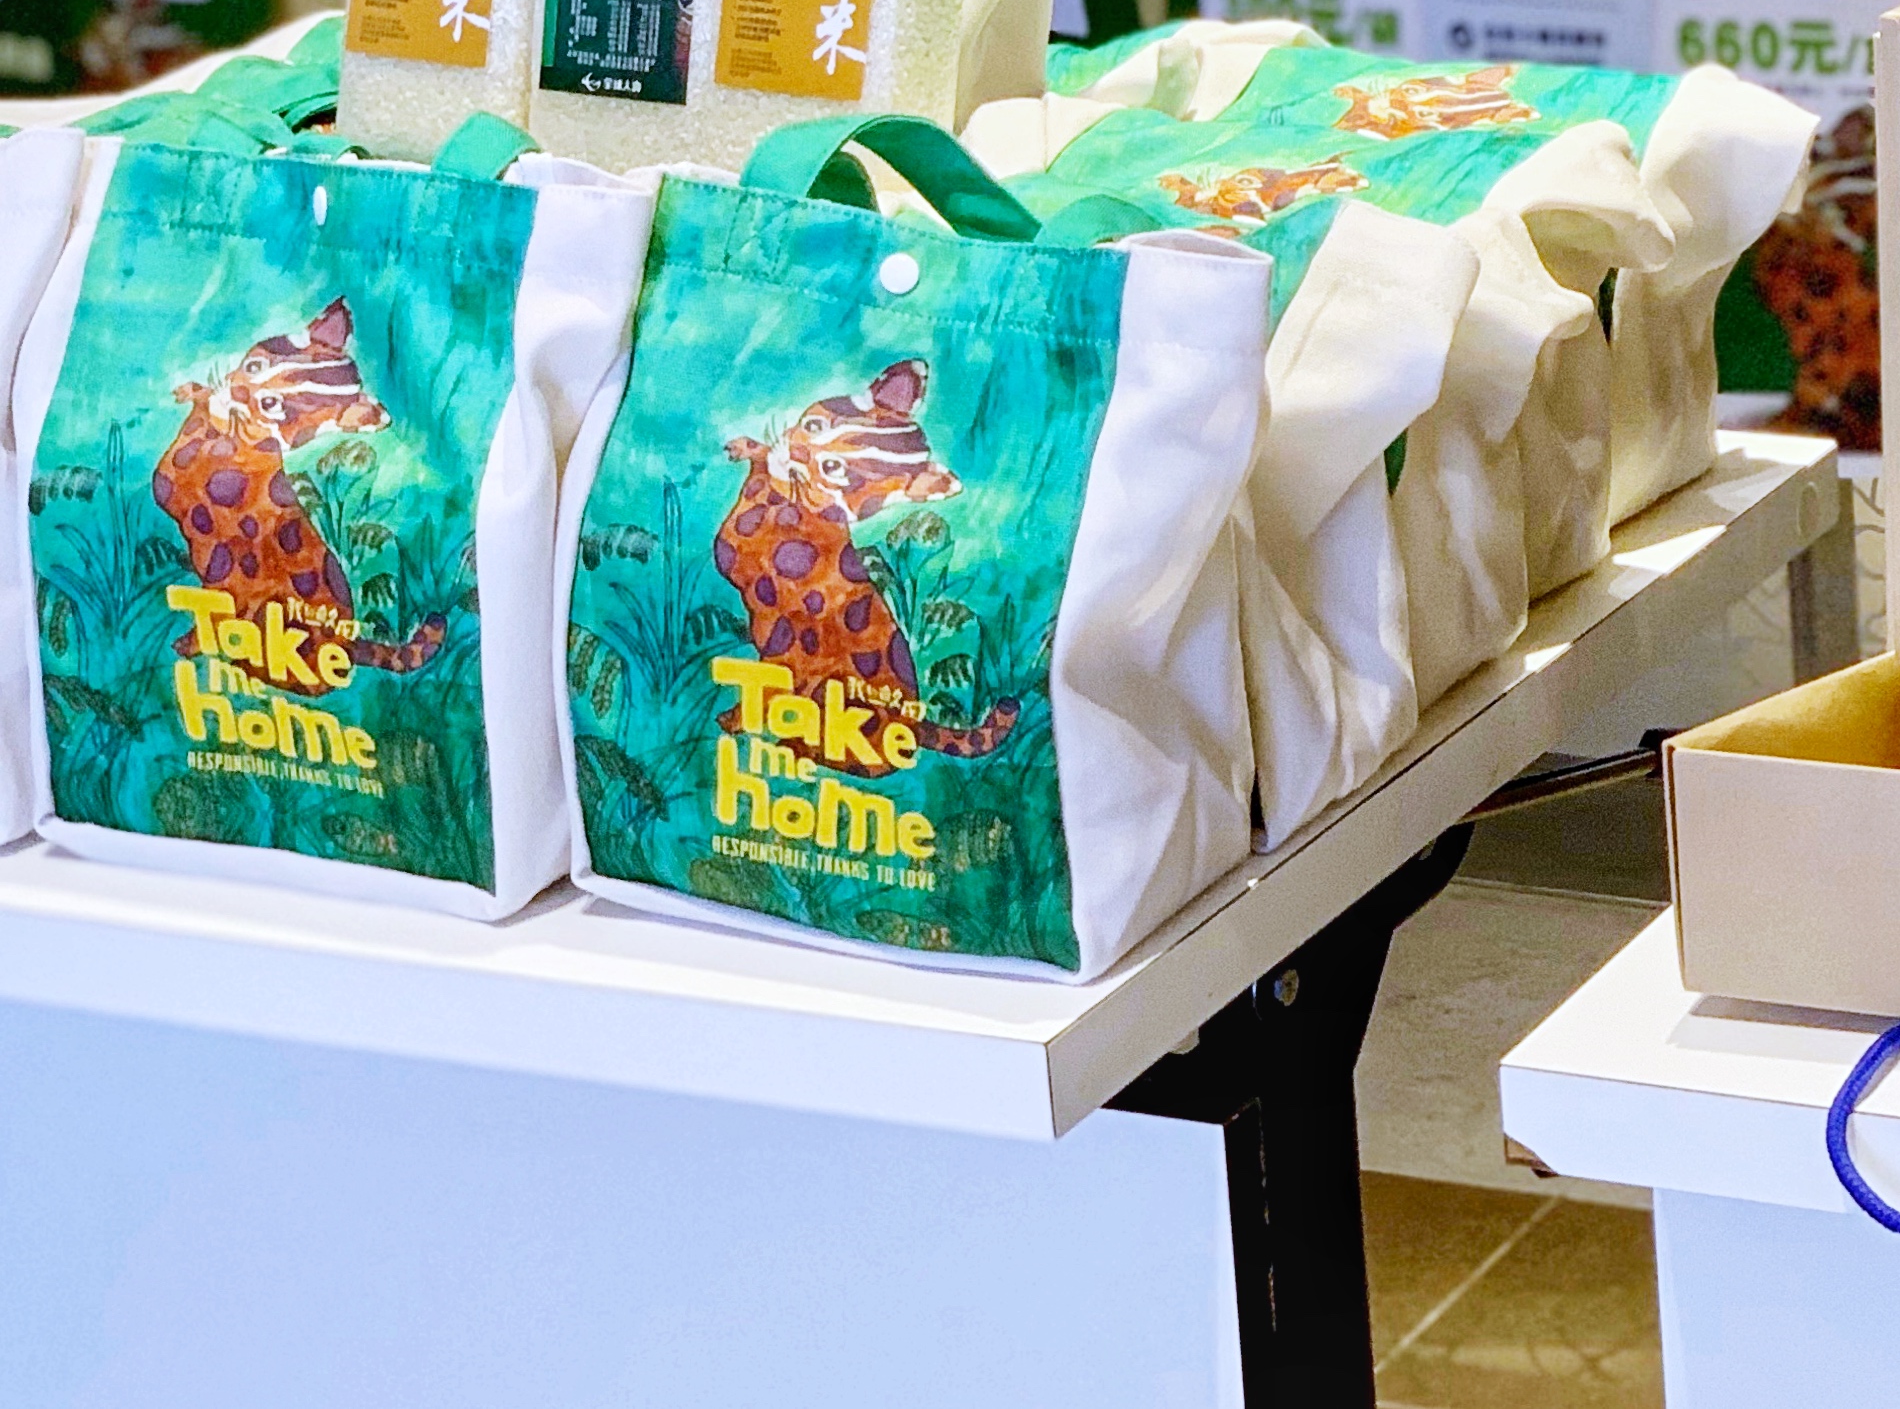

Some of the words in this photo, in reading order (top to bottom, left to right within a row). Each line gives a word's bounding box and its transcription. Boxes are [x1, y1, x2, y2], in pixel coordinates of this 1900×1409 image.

[1678, 18, 1874, 75] 660元/
[167, 585, 353, 688] Take
[209, 658, 267, 698] me
[175, 659, 377, 769] home
[712, 656, 918, 769] Take
[750, 738, 818, 783] me
[716, 734, 936, 859] home
